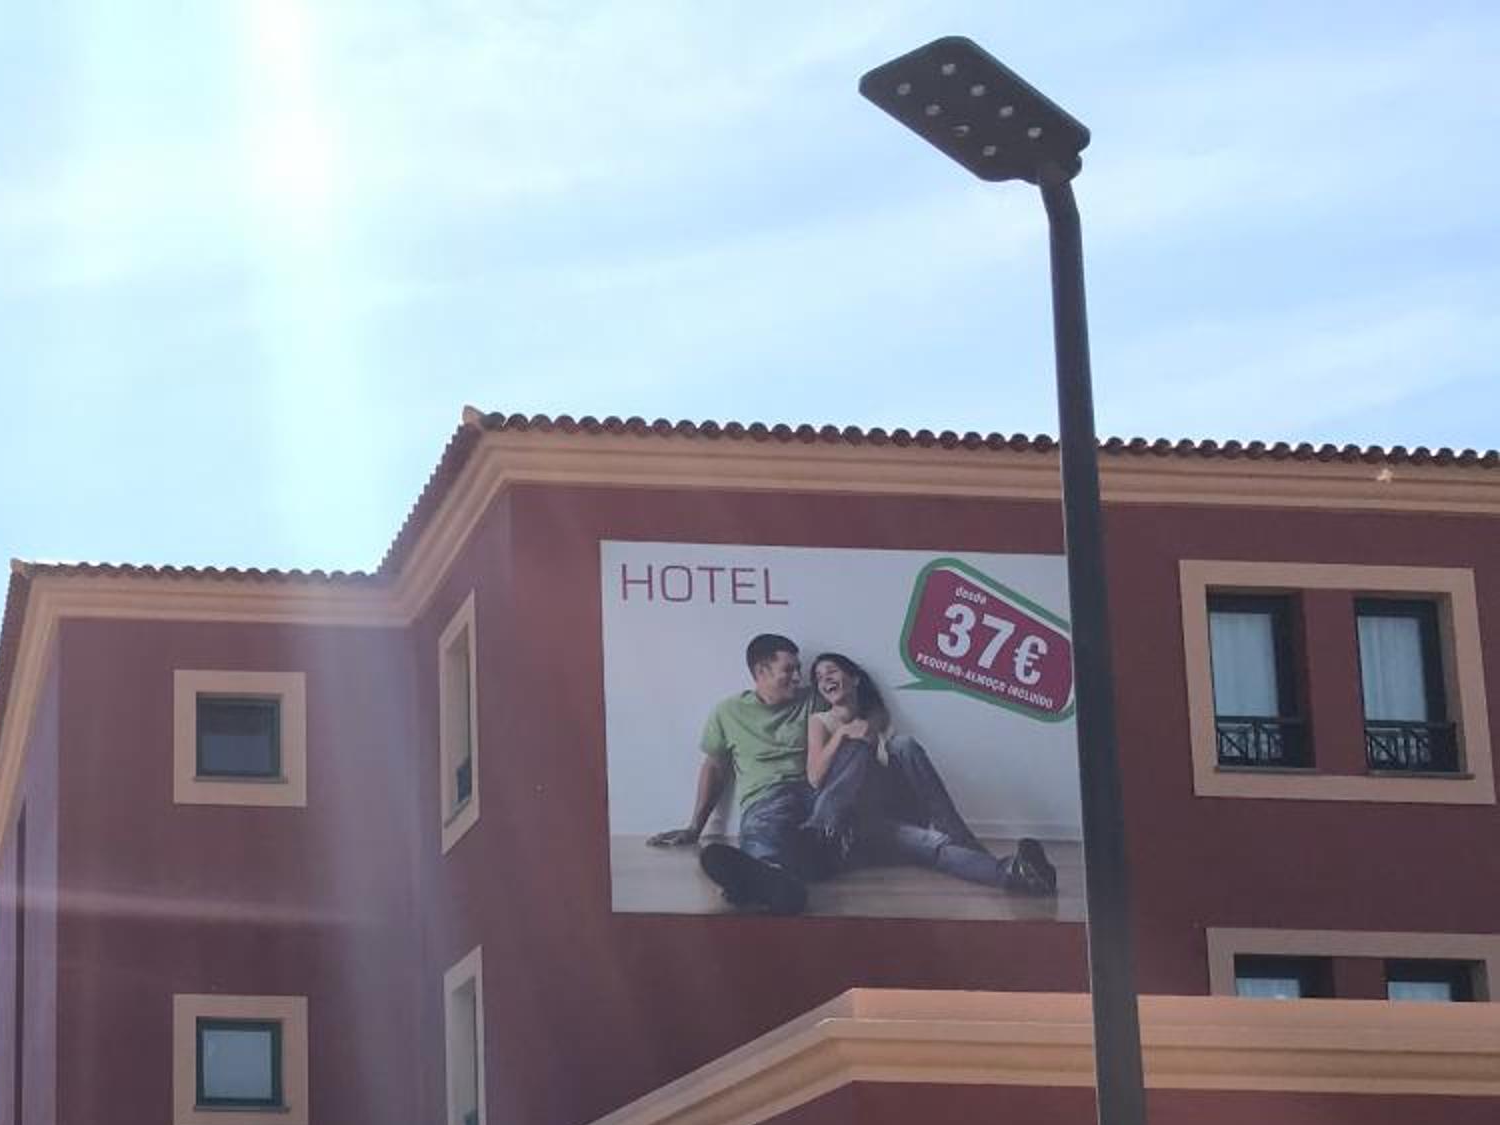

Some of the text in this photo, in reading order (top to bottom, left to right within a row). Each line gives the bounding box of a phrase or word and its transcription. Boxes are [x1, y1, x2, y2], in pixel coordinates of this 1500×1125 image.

[621, 563, 789, 605] HOTEL
[955, 587, 987, 604] desde
[937, 603, 1048, 685] 37€
